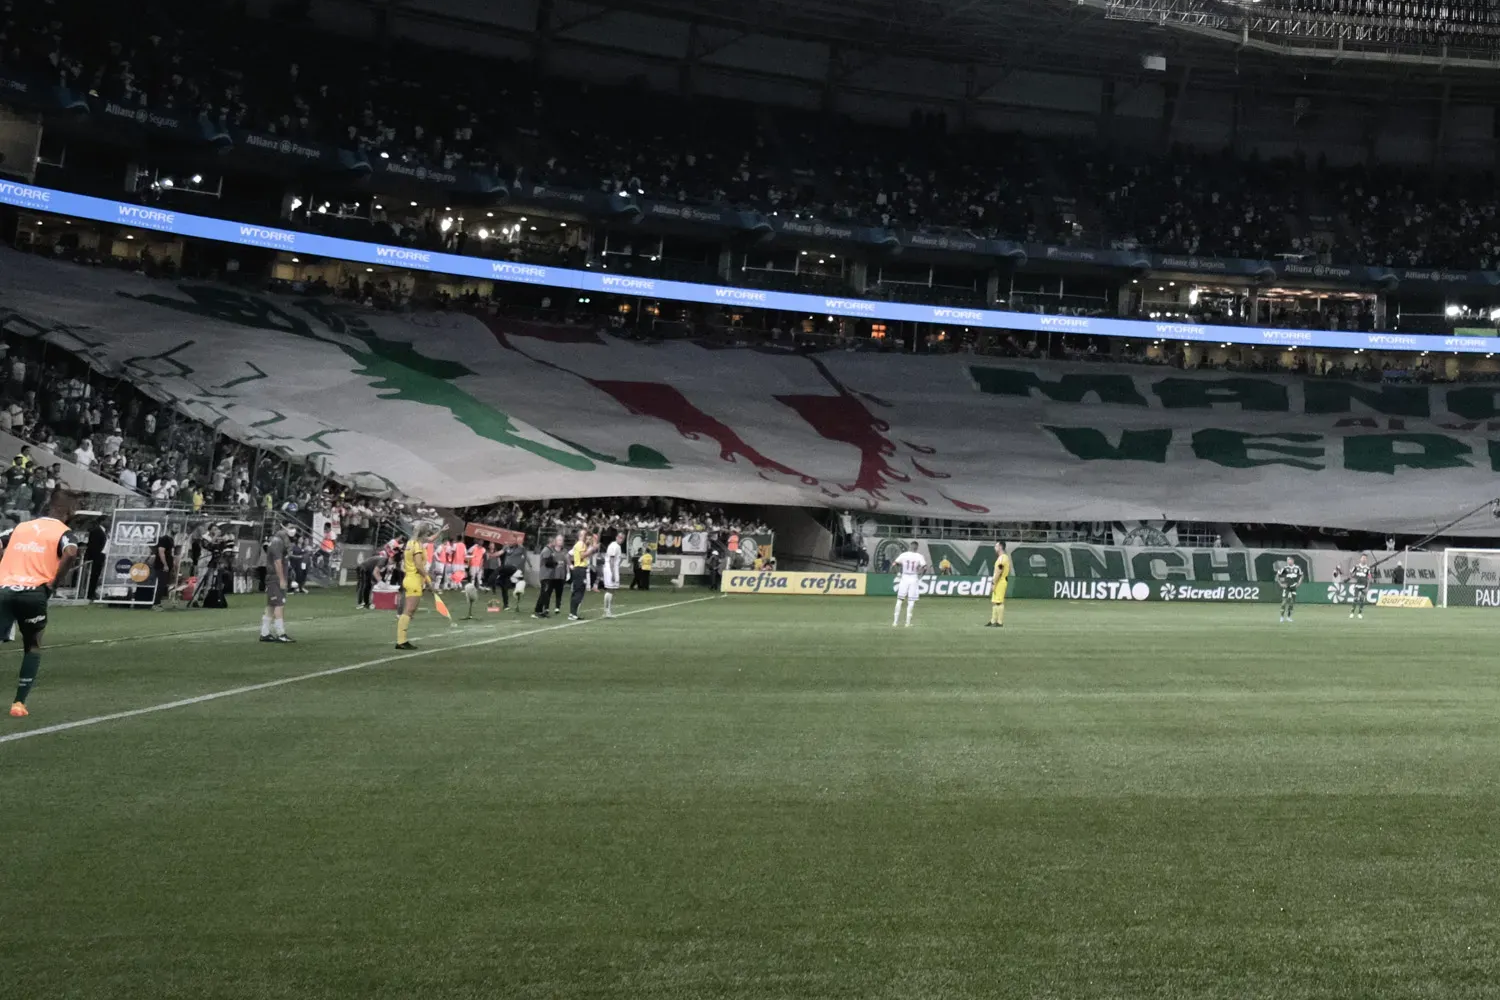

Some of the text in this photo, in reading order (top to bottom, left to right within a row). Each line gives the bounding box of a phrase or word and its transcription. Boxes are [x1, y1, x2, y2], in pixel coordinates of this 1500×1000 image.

[246, 134, 278, 150] Allianz
[119, 206, 174, 223] WTORRE
[782, 221, 811, 233] Allianz
[240, 227, 294, 243] WTORRE
[377, 248, 430, 262] WTORRE
[1162, 257, 1188, 267] Allianz
[493, 264, 545, 276] WTORRE
[1285, 264, 1351, 277] Allianz Parque
[1405, 270, 1429, 280] Allianz
[603, 277, 653, 289] WTORRE
[716, 289, 765, 300] WTORRE
[826, 300, 874, 310] WTORRE
[934, 310, 981, 319] WTORRE
[1041, 318, 1088, 327] WTORRE
[1157, 325, 1204, 334] WTORRE
[1368, 336, 1416, 345] WTORRE
[119, 525, 155, 539] VAR
[906, 560, 917, 571] 11
[730, 571, 788, 592] crefisa
[800, 573, 857, 595] crefisa
[917, 575, 993, 596] Sicredi
[1178, 585, 1225, 600] Sicredi
[1228, 587, 1259, 600] 2022
